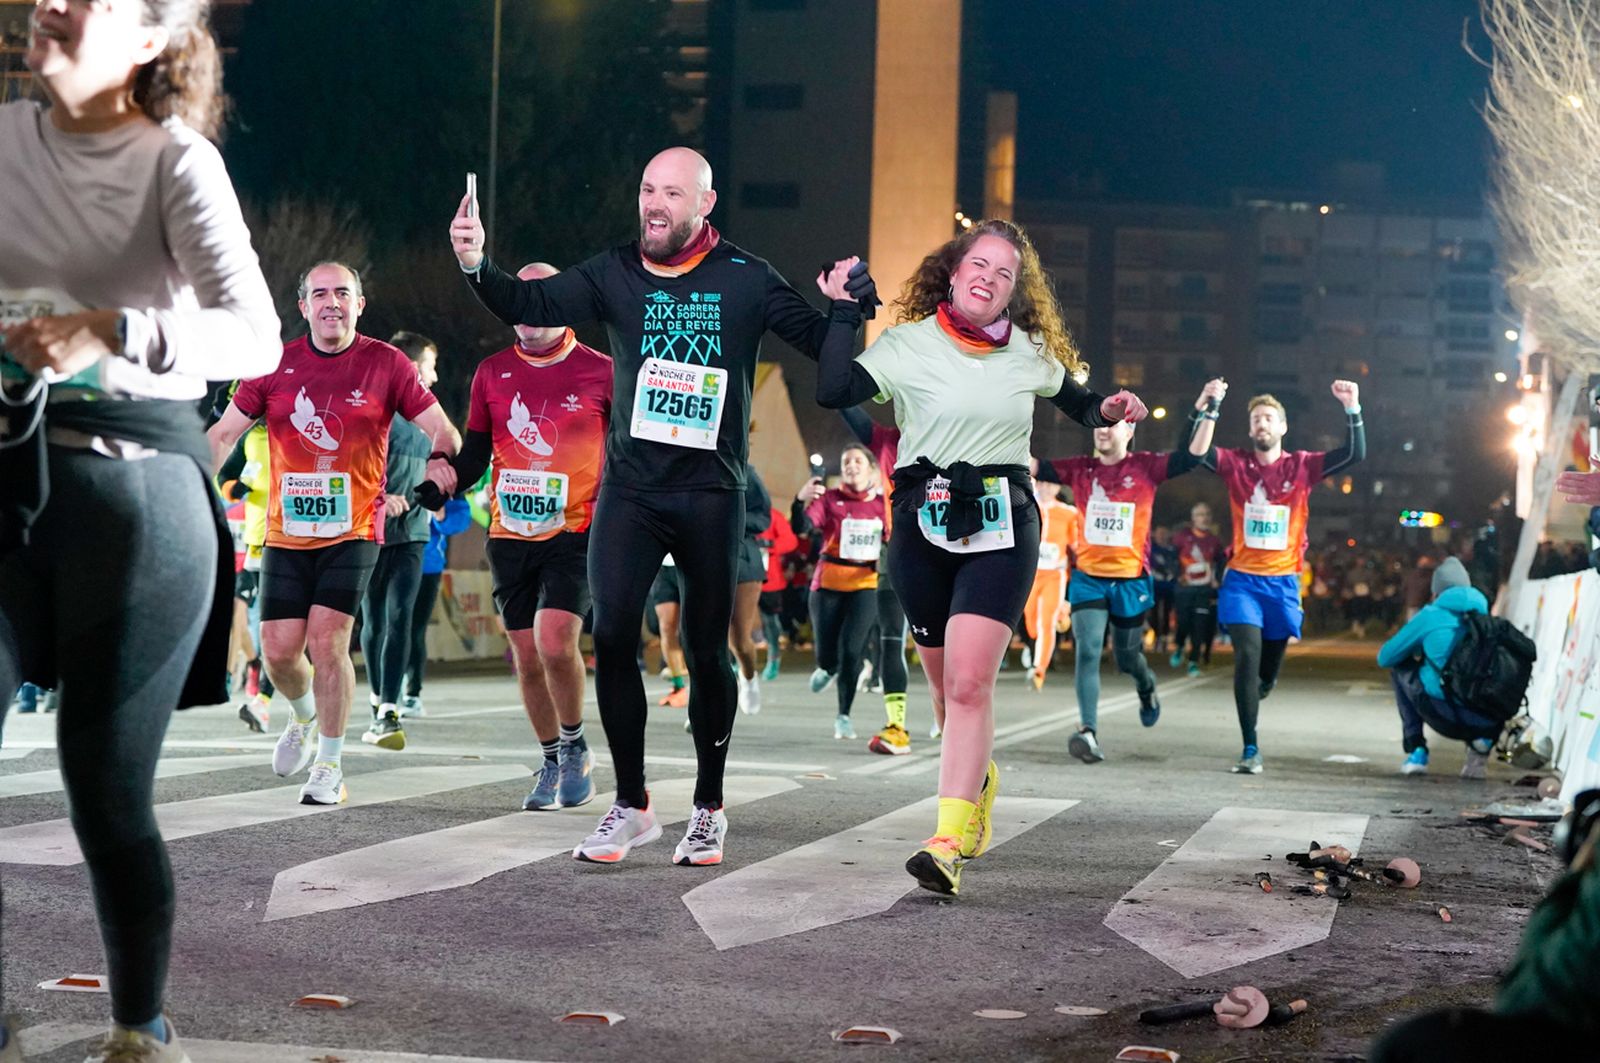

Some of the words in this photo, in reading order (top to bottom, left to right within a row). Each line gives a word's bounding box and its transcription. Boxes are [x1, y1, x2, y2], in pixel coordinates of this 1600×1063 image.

[645, 304, 675, 319] XIX
[677, 304, 721, 312] CARRERA
[677, 312, 720, 320] POPULAR
[644, 319, 664, 330] DÍA
[667, 321, 682, 330] DE
[686, 321, 721, 331] REYES
[659, 369, 683, 380] NOCHE
[685, 374, 696, 382] DE
[647, 378, 663, 388] SAN
[666, 381, 695, 393] ANTON
[646, 389, 713, 421] 12565
[304, 421, 323, 439] 43
[519, 427, 538, 445] 43
[294, 496, 336, 516] 9261
[504, 494, 558, 515] 12054
[927, 498, 999, 526] 120
[1094, 517, 1124, 531] 4923
[1253, 520, 1279, 534] 7363
